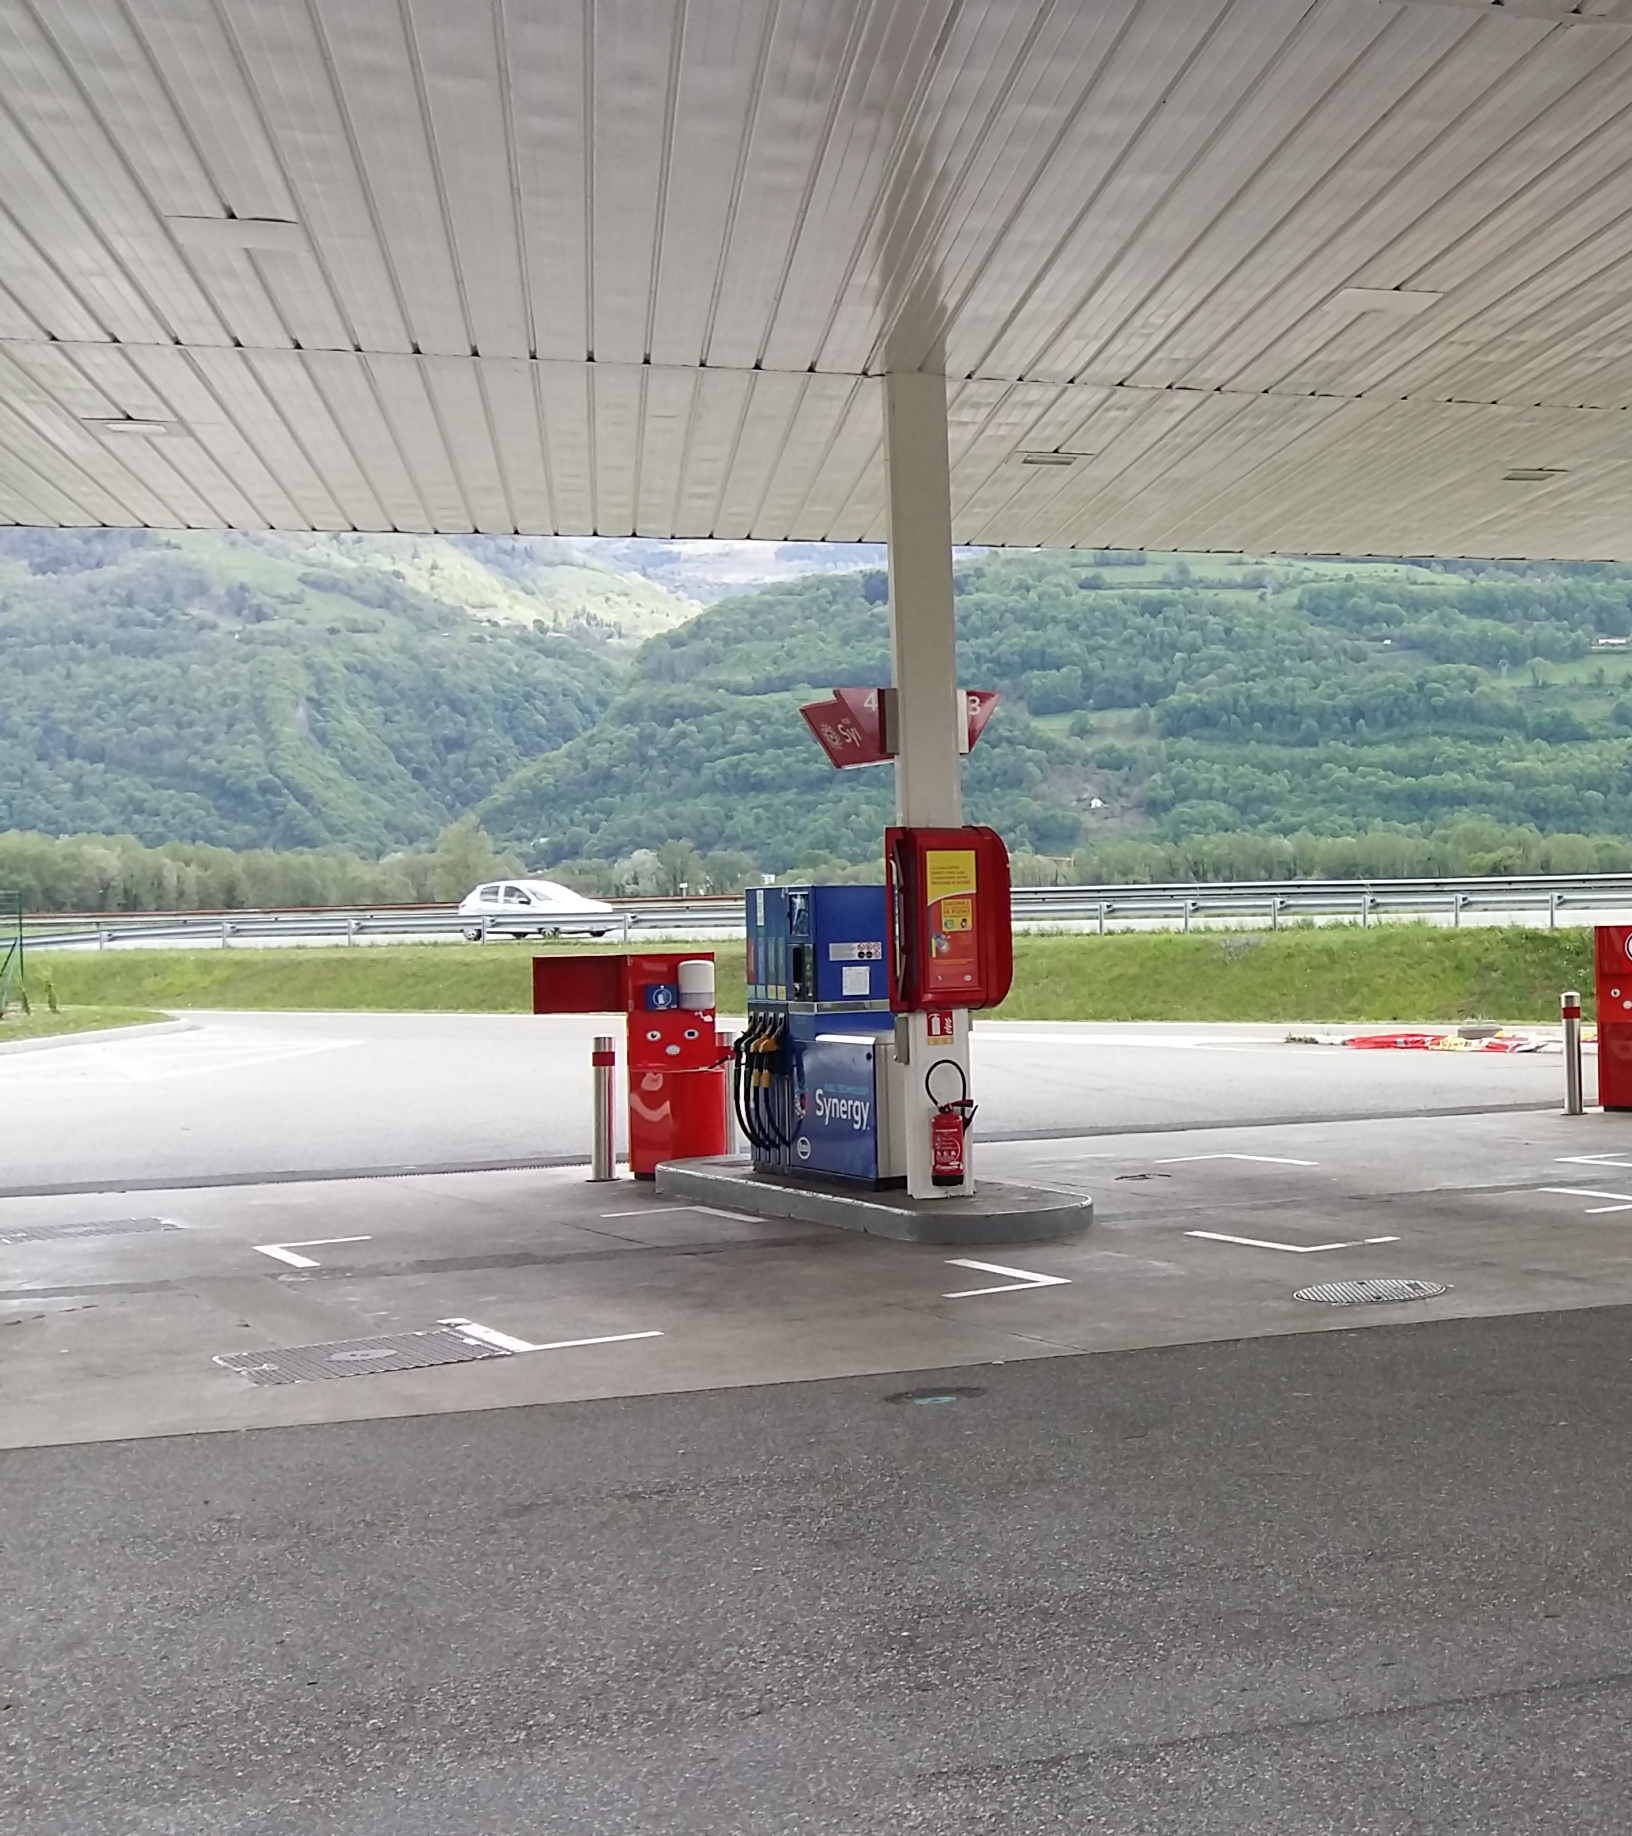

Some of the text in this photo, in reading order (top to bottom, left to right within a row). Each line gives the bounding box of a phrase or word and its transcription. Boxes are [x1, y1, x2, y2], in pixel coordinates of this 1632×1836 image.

[863, 692, 878, 712] 4
[968, 696, 981, 716] 3
[815, 1088, 870, 1130] Synergy
